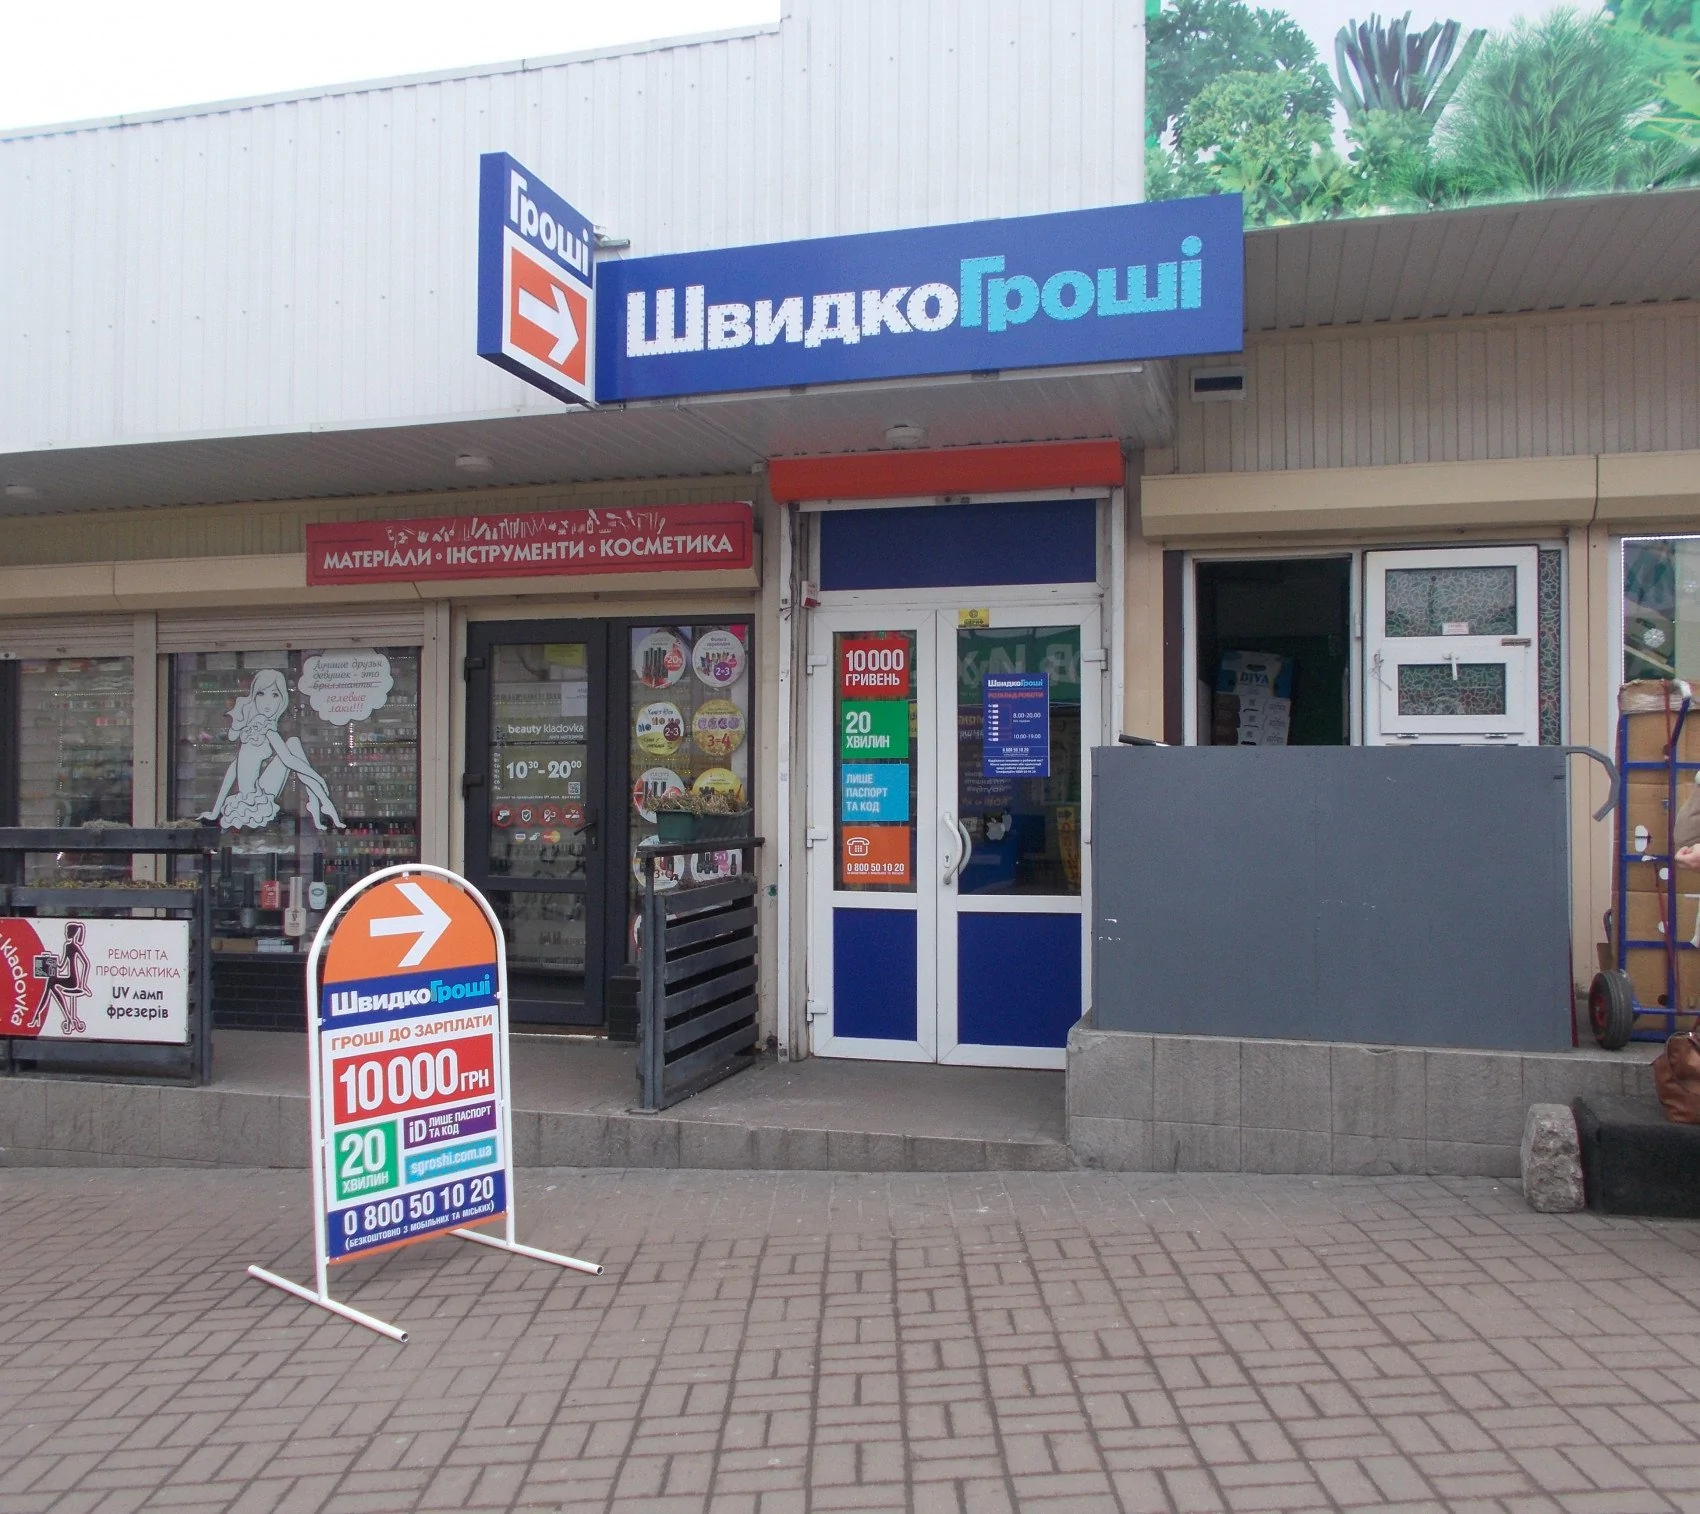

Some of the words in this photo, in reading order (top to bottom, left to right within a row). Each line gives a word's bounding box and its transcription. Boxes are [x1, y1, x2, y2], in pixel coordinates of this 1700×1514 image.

[510, 169, 589, 277] Гроші
[626, 235, 1202, 358] ШвидкоГроші
[323, 545, 432, 569] МАТЕРІАЛИ
[446, 540, 584, 565] ІНСТРУМЕНТИ
[600, 534, 733, 558] КОСМЕТИКА
[313, 660, 348, 671] Лучшие
[352, 657, 382, 670] друзья
[313, 670, 351, 681] девушек
[361, 671, 380, 679] это
[846, 673, 900, 686] ГРИВЕНЬ
[988, 679, 1043, 687] ШвидкоГроші
[326, 692, 366, 703] гелевые
[508, 724, 542, 735] beauty
[543, 723, 584, 733] kladovka
[846, 711, 871, 733] 20
[846, 735, 890, 749] ХВИЛИН
[846, 774, 873, 784] ЛИШЕ
[846, 787, 887, 797] ПАСПОРТ
[846, 801, 858, 811] ТА
[860, 801, 879, 813] КОД
[847, 863, 852, 872] 0
[854, 863, 869, 872] 800
[871, 863, 880, 871] 50
[883, 863, 892, 871] 10
[894, 863, 904, 871] 20
[108, 948, 151, 960] РЕМОНТ
[155, 949, 168, 961] ТА
[96, 966, 180, 978] ПРОФІЛАКТИКА
[0, 938, 29, 1026] kladovka
[112, 987, 130, 999] UV
[133, 989, 163, 1000] ламп
[331, 974, 491, 1016] ШвидкоГроші
[106, 1004, 169, 1020] фрезерів
[332, 1031, 383, 1050] ГРОШІ
[389, 1027, 411, 1043] ДО
[415, 1014, 492, 1037] ЗАРПЛАТИ
[460, 1069, 490, 1092] ГРН
[428, 1113, 453, 1128] ЛИШЕ
[455, 1105, 491, 1122] ПАСПОРТ
[429, 1127, 441, 1139] ТА
[442, 1124, 459, 1137] КОД
[341, 1128, 386, 1178] 20
[410, 1145, 492, 1176] sgroshi.com.ua
[342, 1171, 389, 1194] ХВИЛИН
[344, 1211, 357, 1235] 0
[364, 1198, 404, 1231] 800
[409, 1191, 435, 1219] 50
[440, 1184, 464, 1210] 10
[470, 1176, 494, 1201] 20
[345, 1228, 400, 1250] (БЕЗКОШТОВНО
[410, 1216, 449, 1231] МОБІЛЬНИХ
[452, 1212, 460, 1221] ТА
[463, 1200, 495, 1218] МІСЬКИХ)
